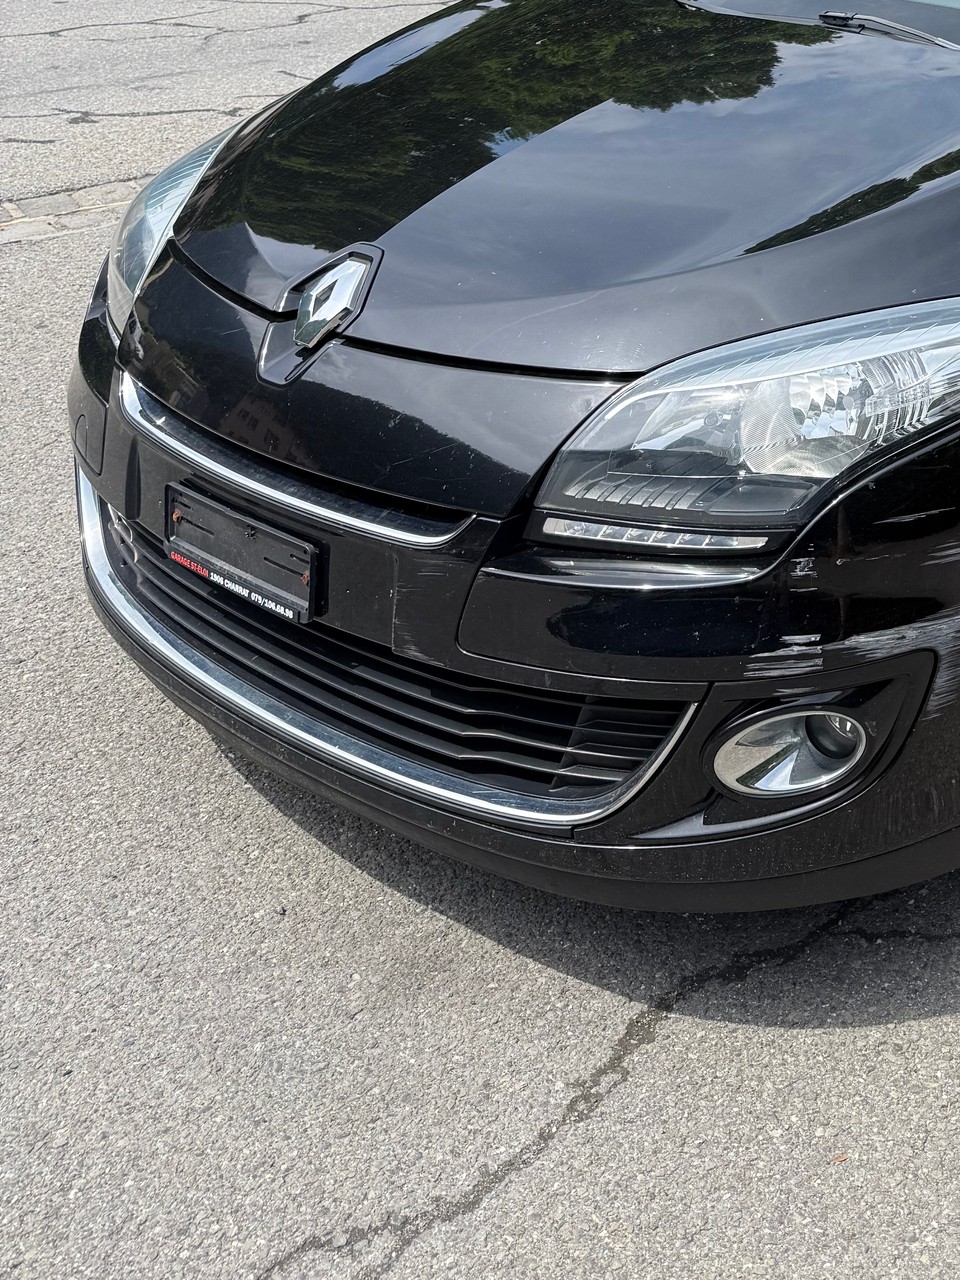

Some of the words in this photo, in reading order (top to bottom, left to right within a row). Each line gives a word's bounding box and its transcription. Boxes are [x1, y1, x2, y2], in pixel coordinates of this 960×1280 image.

[170, 551, 191, 568] GARAGE
[210, 572, 224, 585] 1906
[224, 579, 250, 598] CHARRAT
